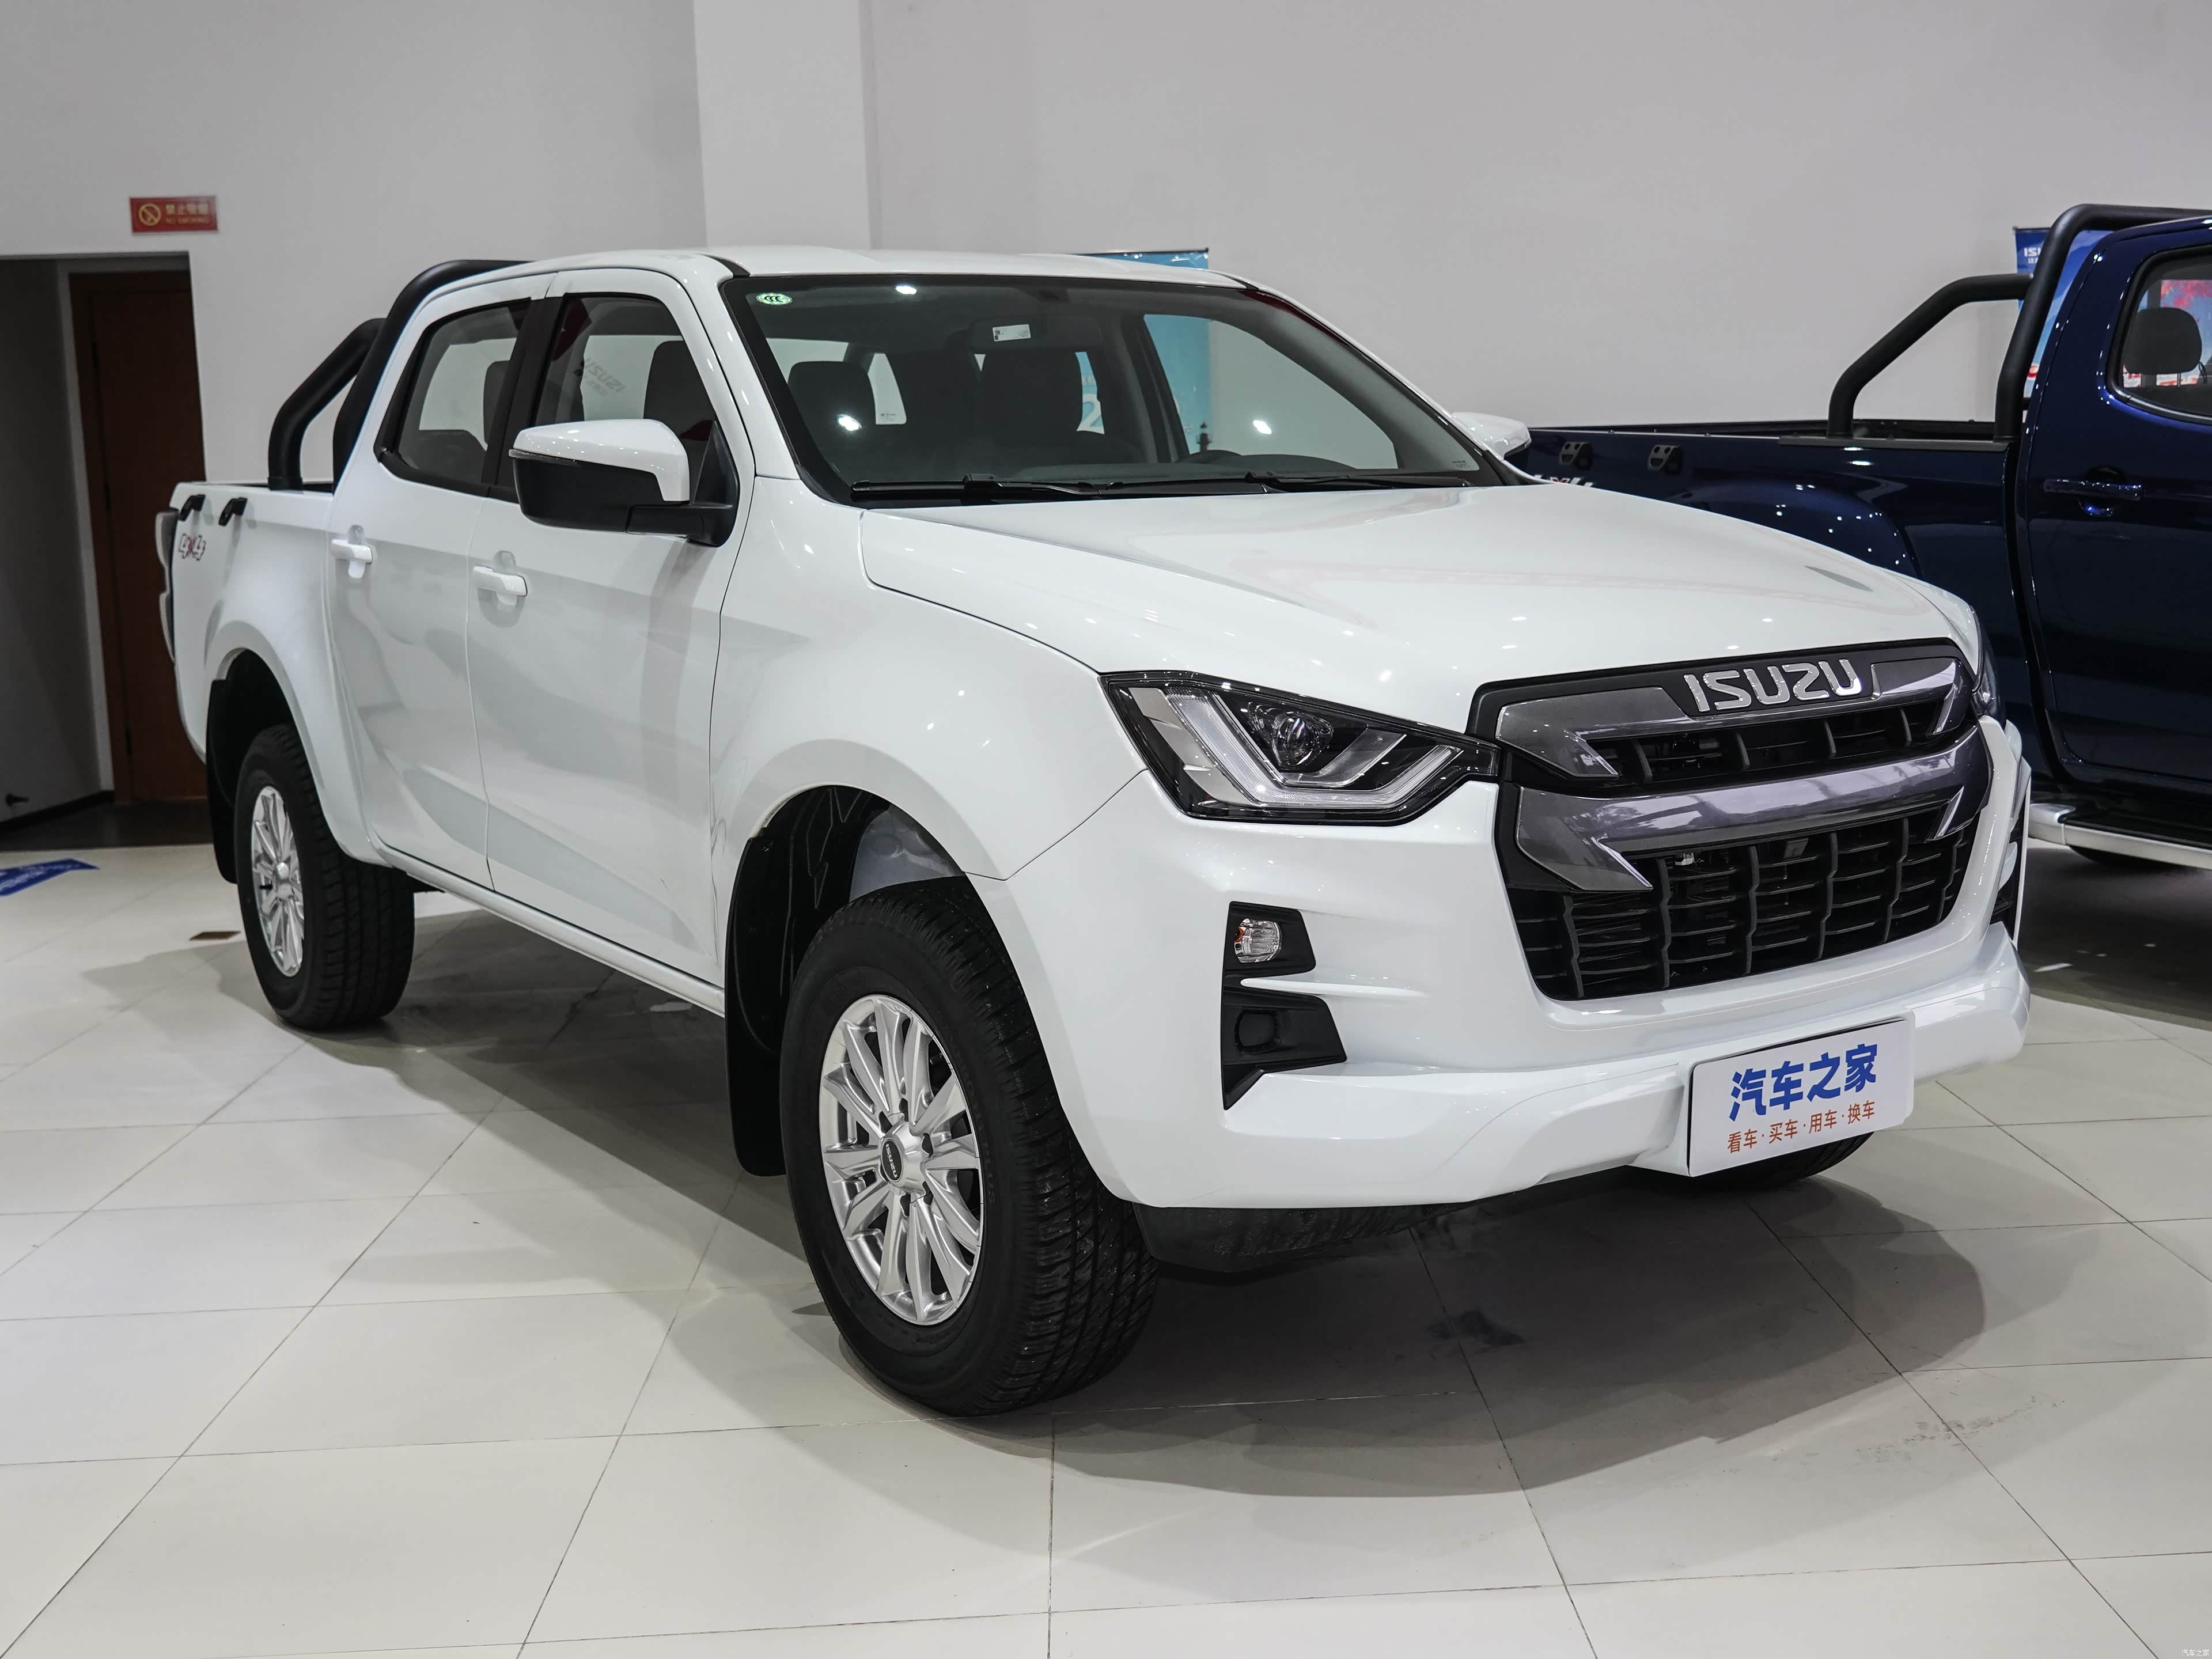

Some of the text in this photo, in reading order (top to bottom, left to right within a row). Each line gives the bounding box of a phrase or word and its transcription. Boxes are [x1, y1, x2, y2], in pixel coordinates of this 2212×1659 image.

[1683, 658, 1862, 712] ISUZU
[1729, 1043, 1877, 1122] 汽车之家
[885, 1143, 898, 1179] ISUZU
